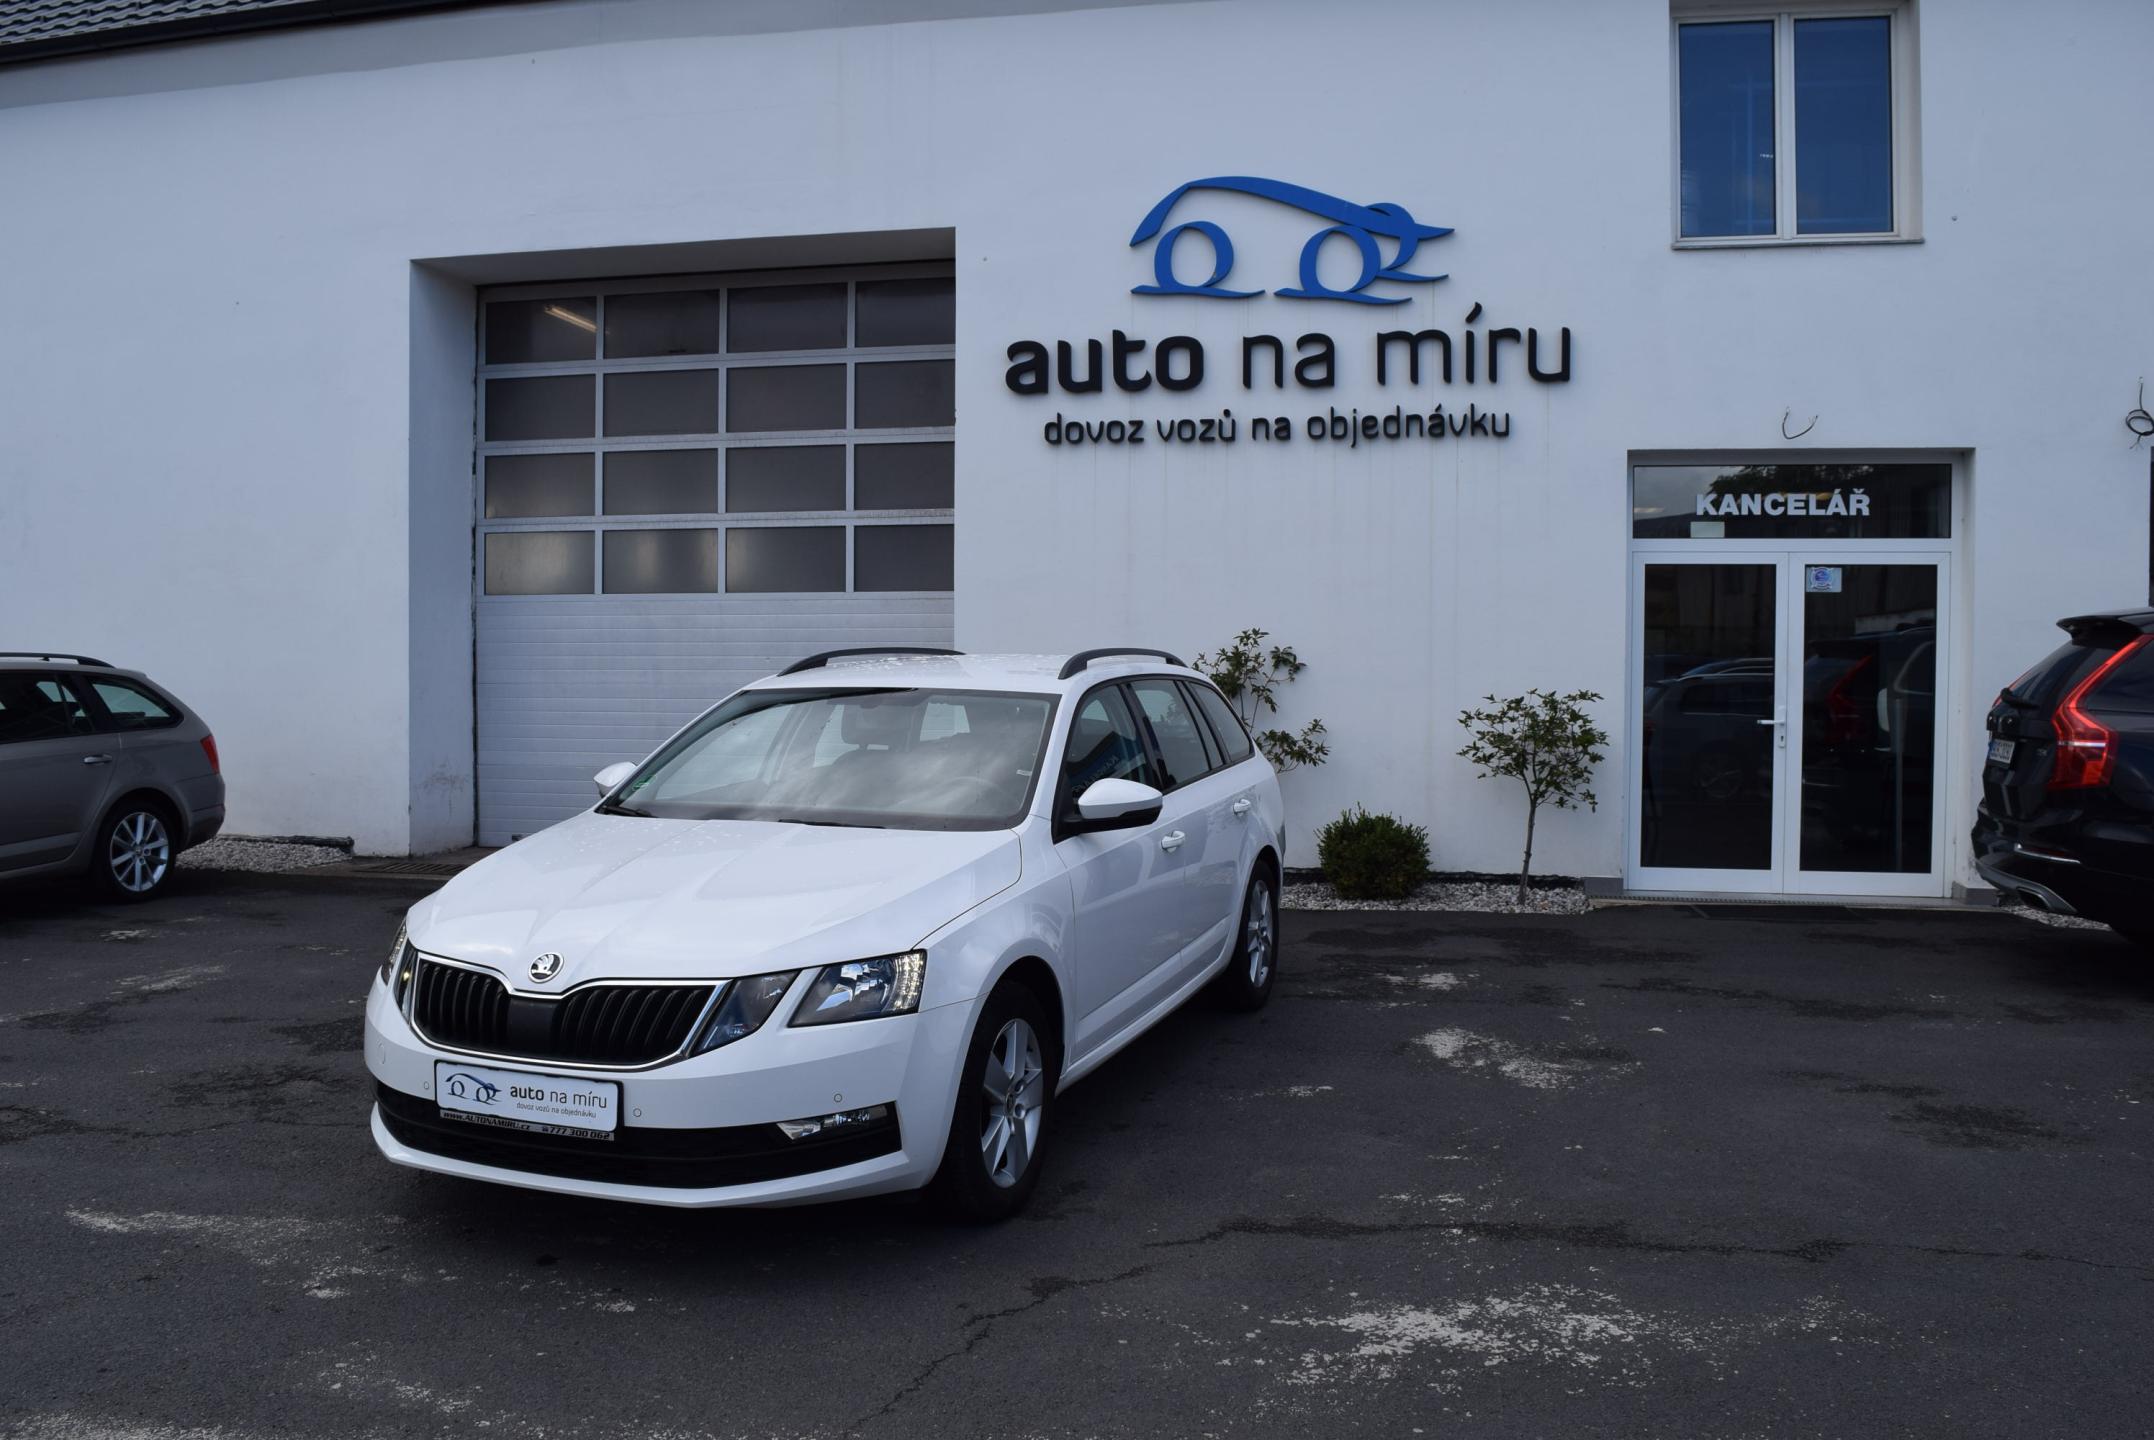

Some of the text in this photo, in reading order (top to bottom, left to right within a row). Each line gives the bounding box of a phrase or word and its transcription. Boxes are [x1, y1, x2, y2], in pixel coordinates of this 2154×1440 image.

[1005, 302, 1570, 394] auto na míru
[1044, 403, 1510, 448] dovoz vozů na objednávku
[1696, 488, 1870, 516] KANCELÁŘ
[510, 1085, 607, 1109] auto na míru
[516, 1102, 534, 1111] dovoz
[551, 1106, 560, 1114] na
